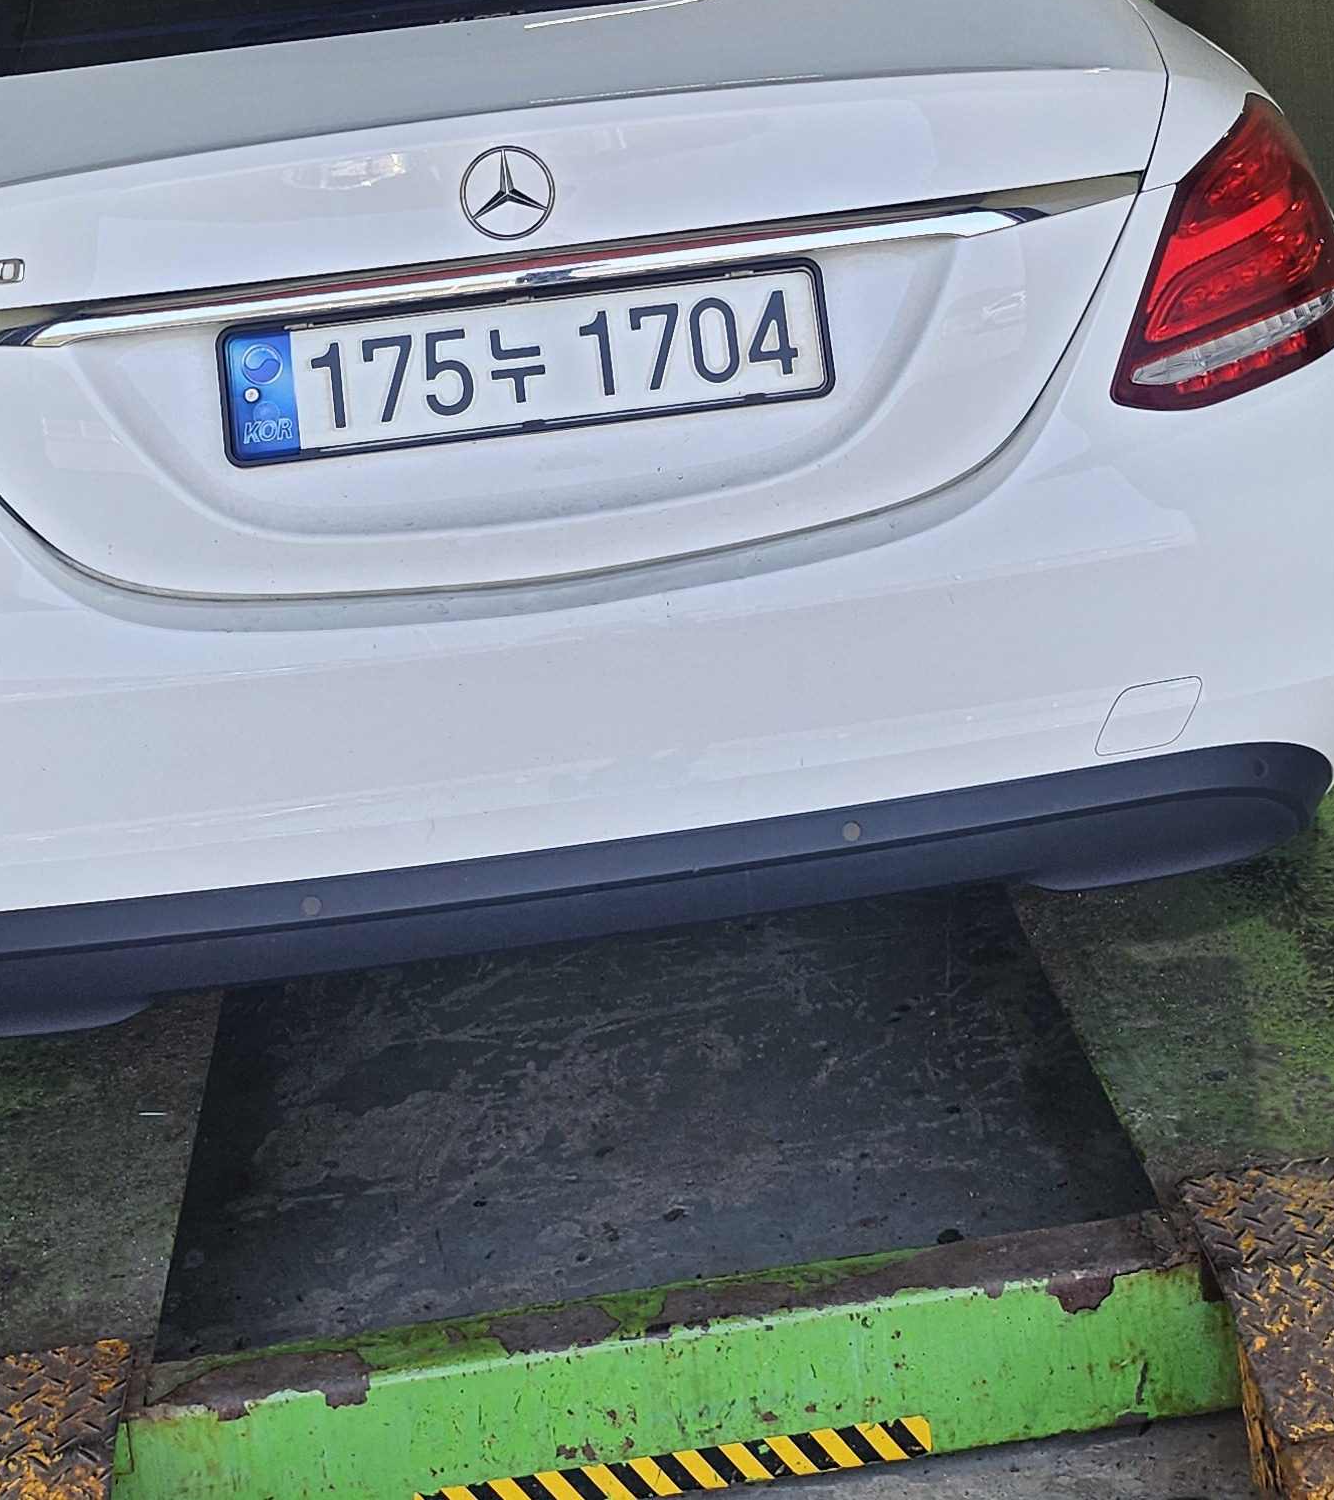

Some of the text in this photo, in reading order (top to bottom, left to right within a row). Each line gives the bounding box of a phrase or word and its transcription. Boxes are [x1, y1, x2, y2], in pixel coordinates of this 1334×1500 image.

[310, 290, 799, 429] 175누 1704
[243, 418, 293, 444] KOR
